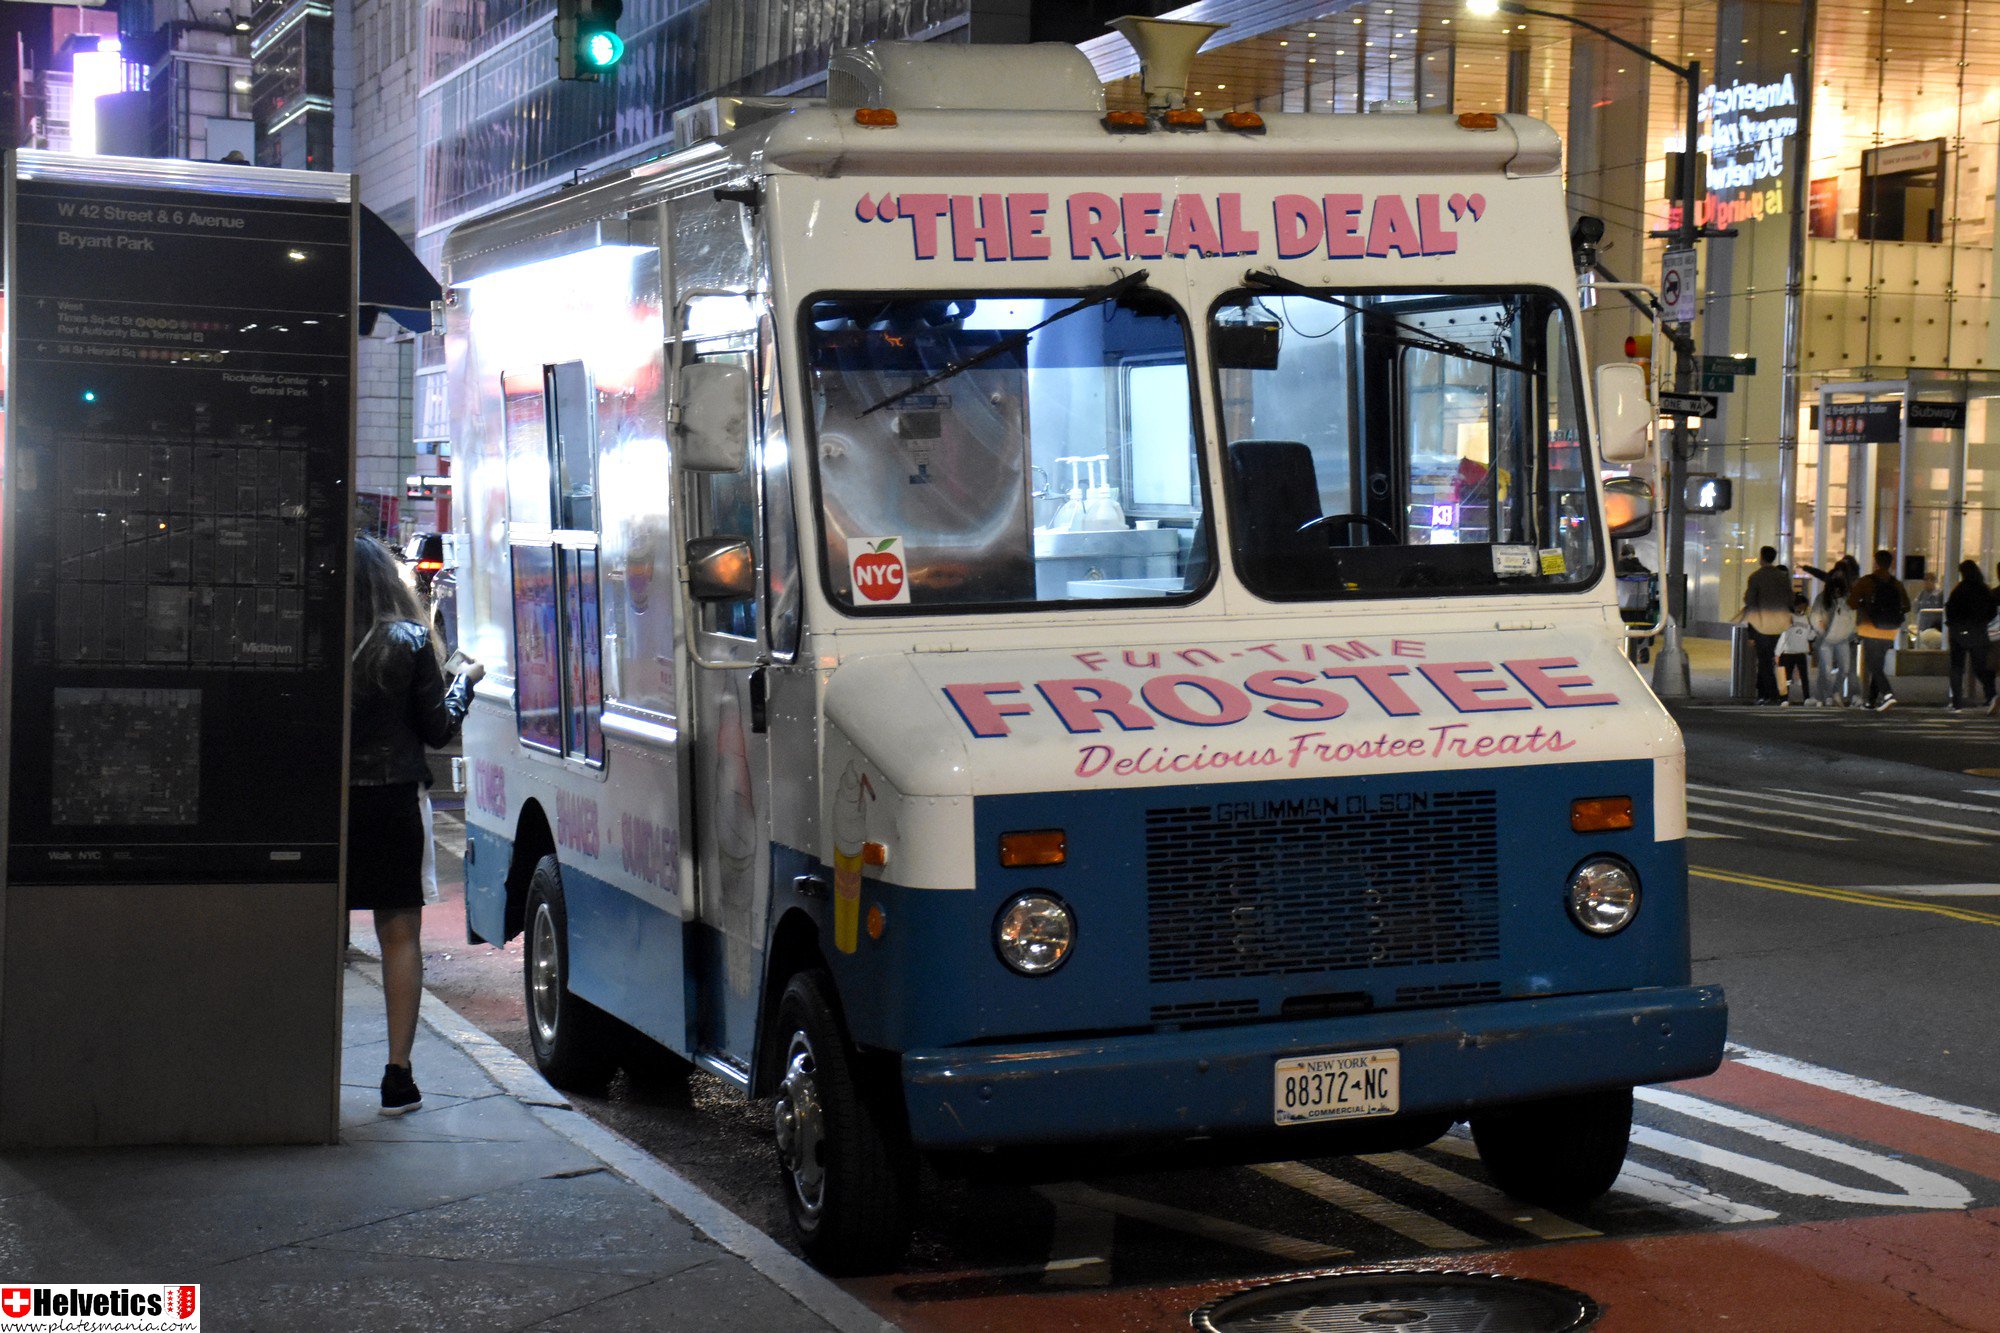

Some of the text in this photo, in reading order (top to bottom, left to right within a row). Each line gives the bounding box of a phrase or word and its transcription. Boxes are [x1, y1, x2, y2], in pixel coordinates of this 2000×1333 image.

[57, 203, 245, 229] W 42 Street & 6 Avenue
[1067, 191, 1260, 260] REAL
[57, 232, 155, 251] Bryant Park
[57, 301, 84, 311] West
[57, 312, 87, 324] Times
[57, 325, 192, 343] Port Authority Bus Terminal
[222, 373, 309, 386] Rockefeller Center
[249, 386, 309, 398] Central Park
[1663, 399, 1709, 412] ONE WAY
[1910, 405, 1958, 421] Subway
[856, 564, 902, 586] NYC
[241, 641, 293, 655] Midtown
[941, 656, 1620, 740] FROSTEE
[1074, 722, 1578, 778] Delicious Frostee Treats
[1216, 791, 1429, 823] GRUMMAN OLSON
[47, 851, 73, 861] Walk
[78, 851, 102, 861] NYC
[1307, 1056, 1369, 1072] NEW YORK
[1285, 1067, 1389, 1107] 88372 NC
[1308, 1105, 1366, 1117] COMMERCIAL
